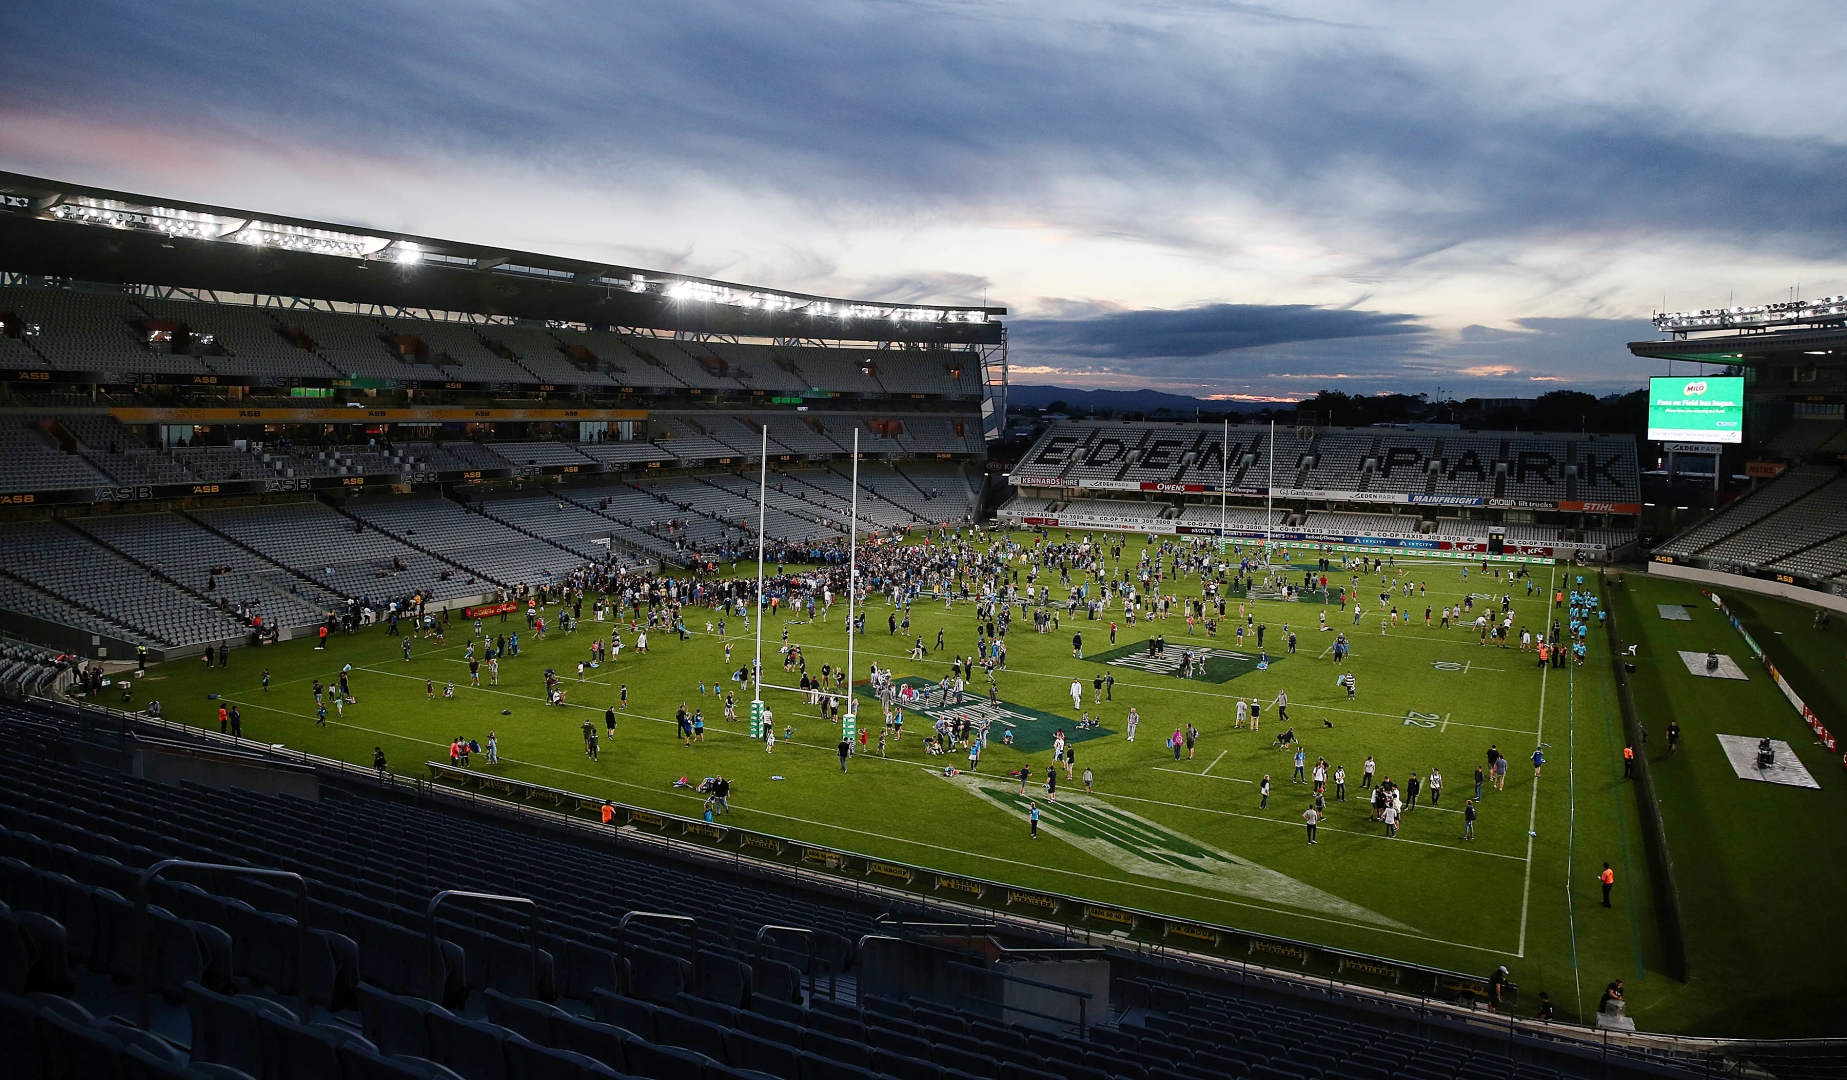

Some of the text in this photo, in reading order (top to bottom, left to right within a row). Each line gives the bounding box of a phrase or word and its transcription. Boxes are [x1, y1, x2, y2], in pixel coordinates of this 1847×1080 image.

[18, 371, 50, 380] ASB
[193, 376, 218, 384] ASB
[331, 379, 352, 387] ASB
[1034, 437, 1625, 488] EDEN PARK
[463, 471, 481, 479] ASB
[265, 478, 311, 492] ASB
[342, 477, 364, 485] ASB
[1022, 477, 1061, 486] KENNARDS
[193, 485, 220, 494] ASB
[1157, 483, 1186, 491] OWENS
[95, 485, 153, 502] ASB
[0, 494, 35, 504] ASB
[1412, 495, 1478, 504] MAINFREIGHT
[1582, 503, 1615, 511] STIHL
[1654, 555, 1674, 563] ASB
[1776, 574, 1794, 584] ASB
[1403, 711, 1441, 728] 22
[884, 867, 908, 876] GROUP
[1016, 896, 1051, 907] TRAILERS
[1184, 927, 1213, 937] GROUP
[1260, 946, 1299, 957] TRAILERS
[1350, 964, 1392, 976] TRAILERS
